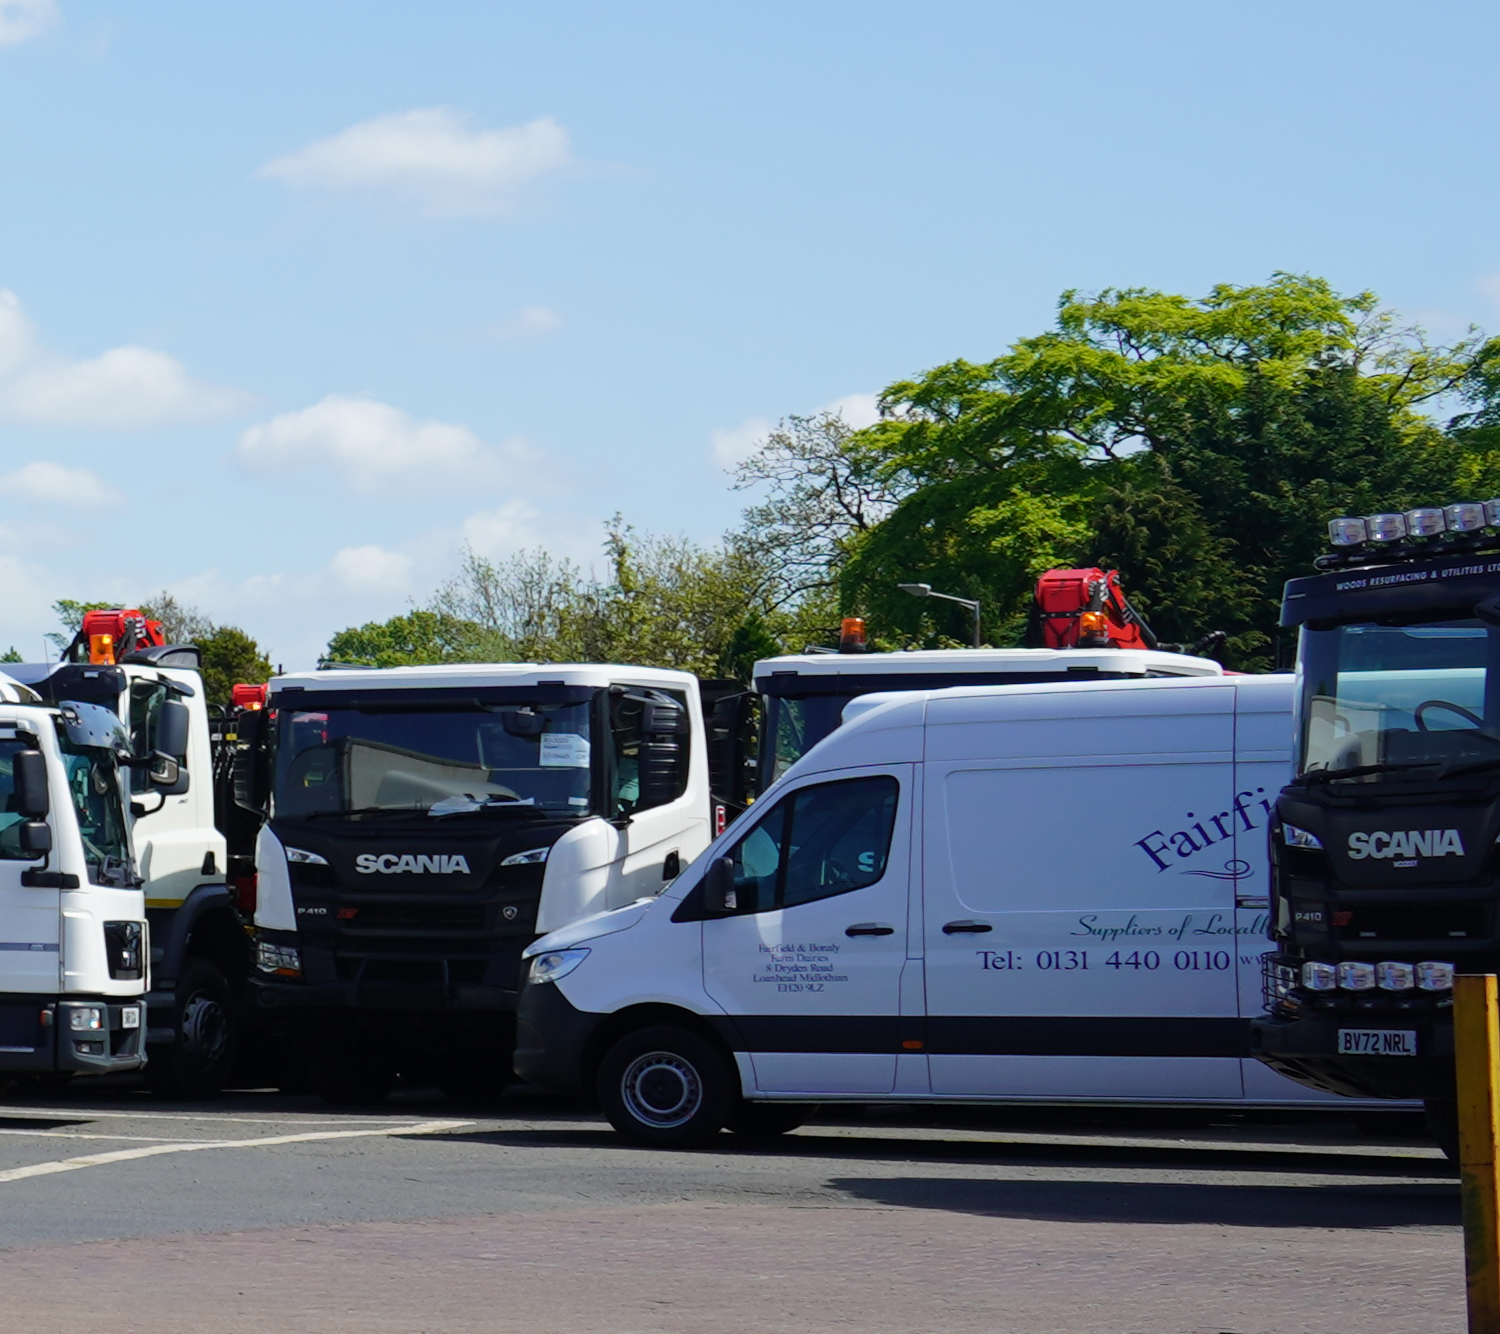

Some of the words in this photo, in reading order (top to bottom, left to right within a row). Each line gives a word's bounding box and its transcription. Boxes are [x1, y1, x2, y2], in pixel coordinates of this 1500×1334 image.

[1369, 570, 1428, 586] RESURFACING
[1430, 569, 1438, 579] &
[1441, 564, 1484, 578] UTILITIES
[1132, 786, 1273, 874] Fairfi
[1347, 828, 1466, 860] SCANIA
[355, 854, 472, 874] SCANIA
[1070, 914, 1162, 941] Suppliers
[1168, 914, 1190, 941] of
[1192, 914, 1269, 937] Locall
[810, 964, 834, 972] Road
[976, 950, 1022, 971] Tel:
[1036, 950, 1088, 971] 0131
[1104, 950, 1160, 971] 440
[1173, 950, 1230, 971] 0110
[1343, 1032, 1380, 1052] BV72
[1383, 1033, 1411, 1053] NRL
